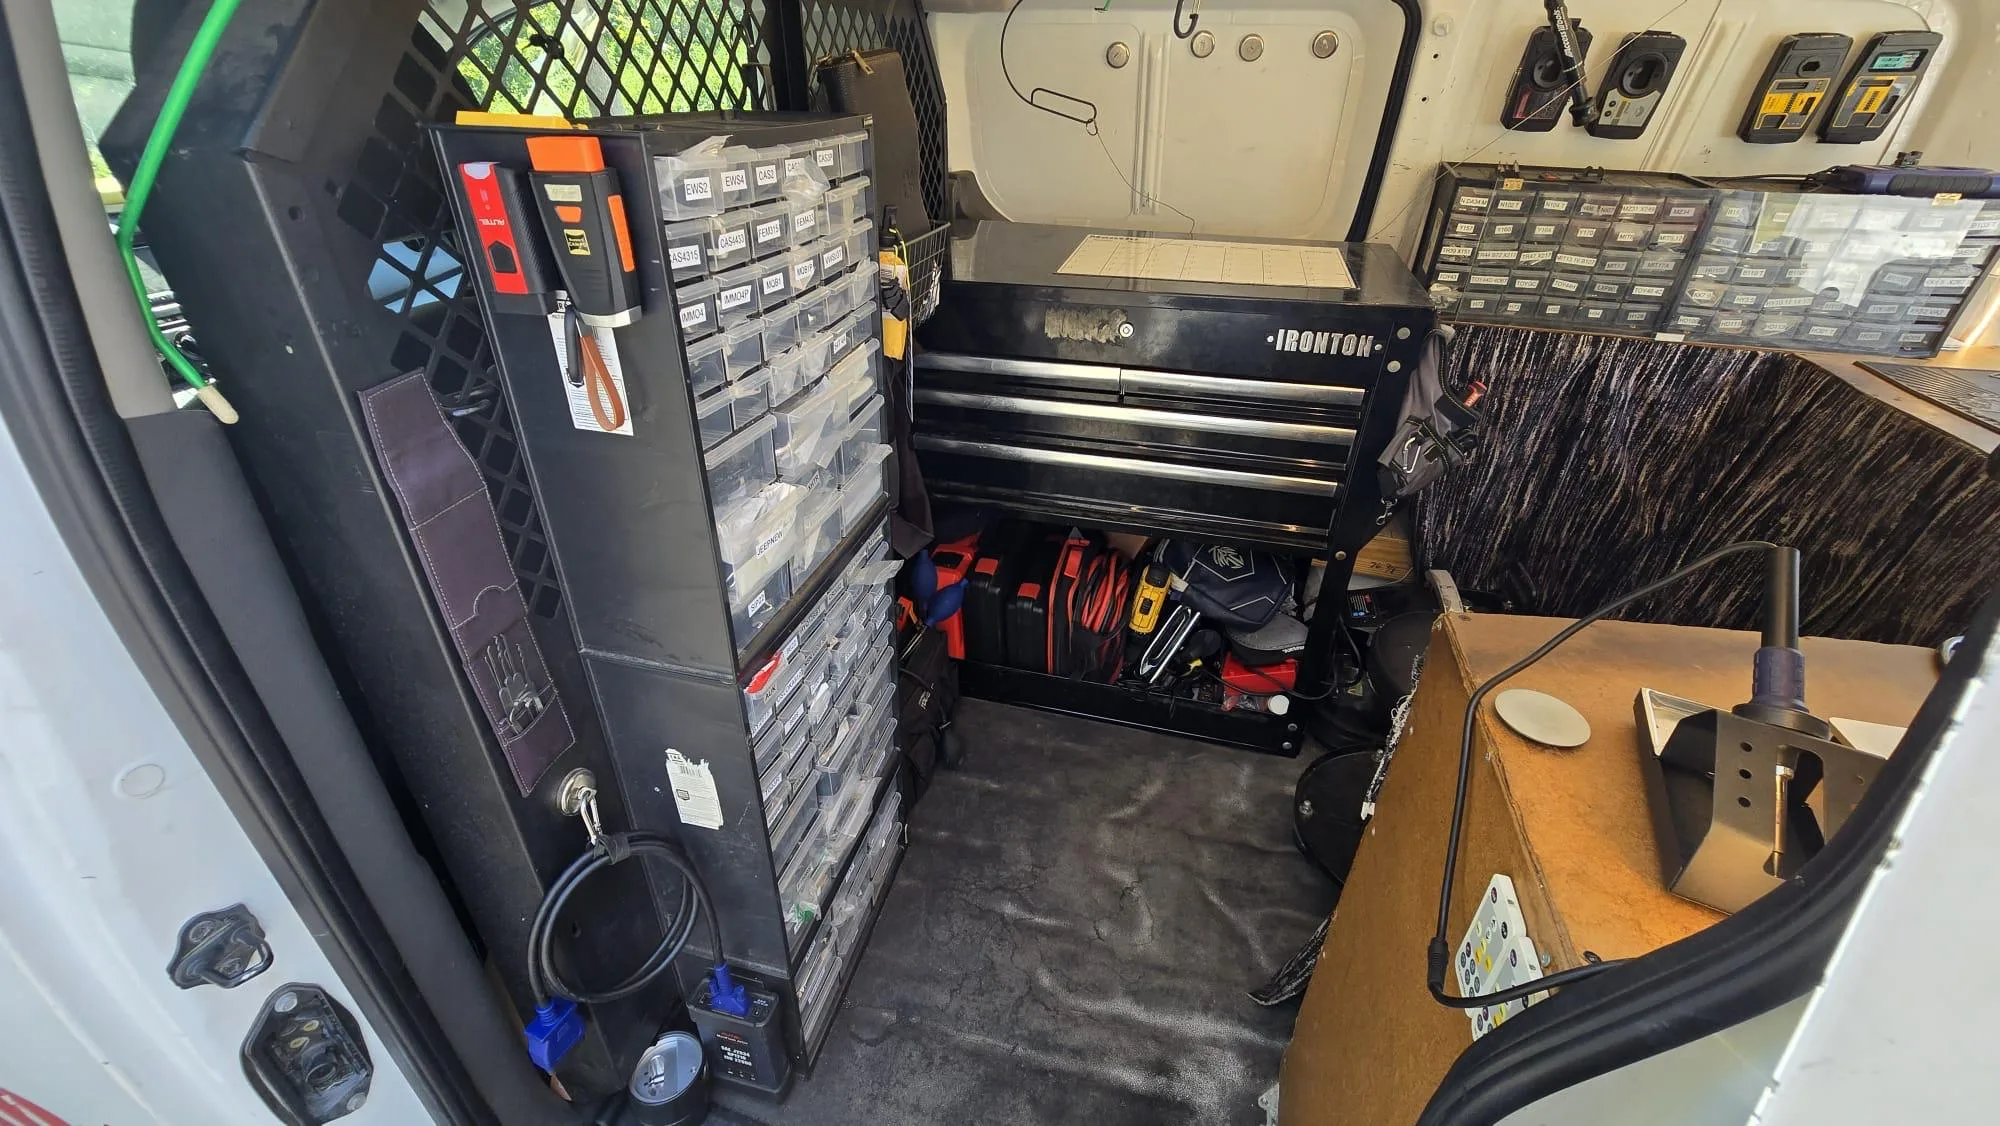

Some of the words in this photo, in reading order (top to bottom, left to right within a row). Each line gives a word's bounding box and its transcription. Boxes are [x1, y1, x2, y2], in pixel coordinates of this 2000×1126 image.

[725, 174, 745, 187] EWS4
[758, 169, 775, 181] CAS2
[686, 182, 709, 195] EWS2
[758, 224, 780, 238] FEM315
[720, 233, 745, 248] CAS4433
[669, 249, 699, 263] AS4315
[766, 277, 782, 289] MQB1
[724, 289, 749, 304] IMMO4P
[681, 308, 704, 322] IMMO4
[1276, 329, 1374, 358] IRONTON
[757, 529, 783, 556] JEEPNEW
